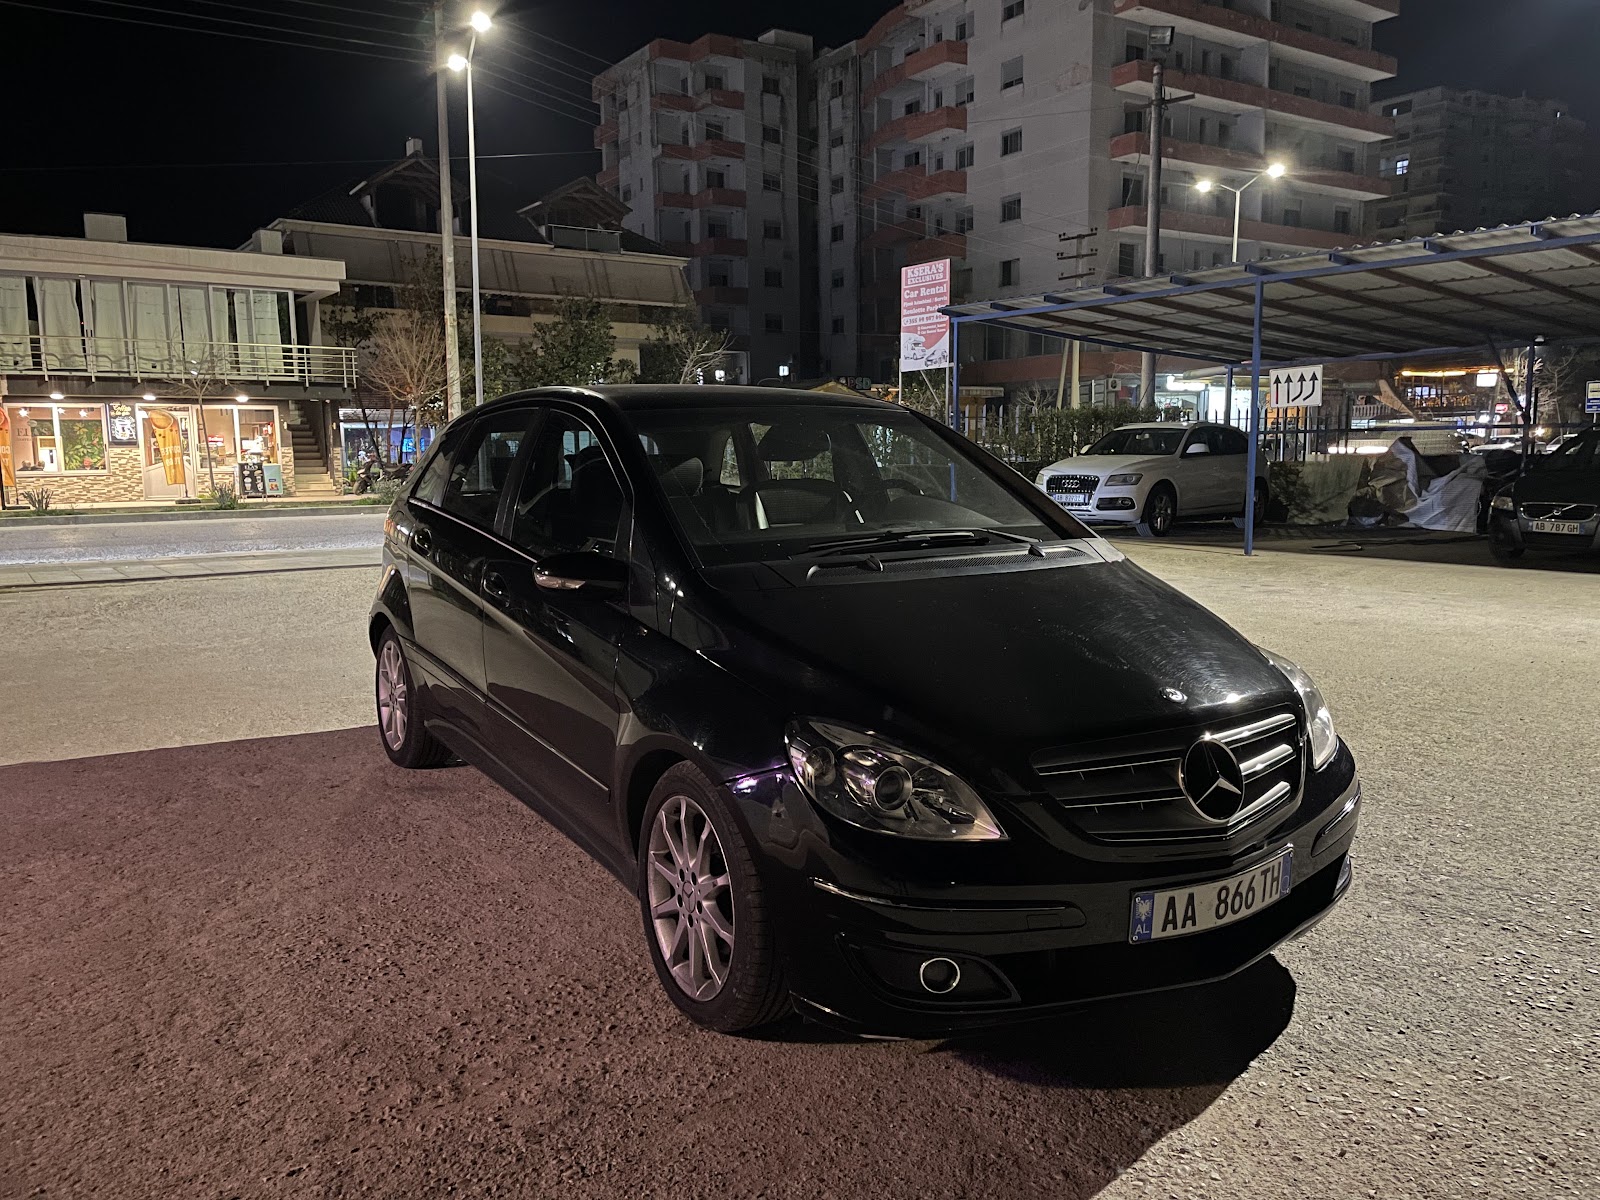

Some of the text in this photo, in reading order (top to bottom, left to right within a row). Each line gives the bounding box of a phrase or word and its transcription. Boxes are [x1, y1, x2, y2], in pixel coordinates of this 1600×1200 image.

[907, 263, 944, 278] KSERA'S
[907, 273, 944, 285] EXCLUSIVES
[903, 283, 947, 299] Car Rental
[1535, 522, 1545, 531] AB
[1549, 522, 1566, 532] 787
[1567, 524, 1579, 533] GH
[1161, 861, 1282, 932] AA 866 TH
[1134, 923, 1150, 935] AL
